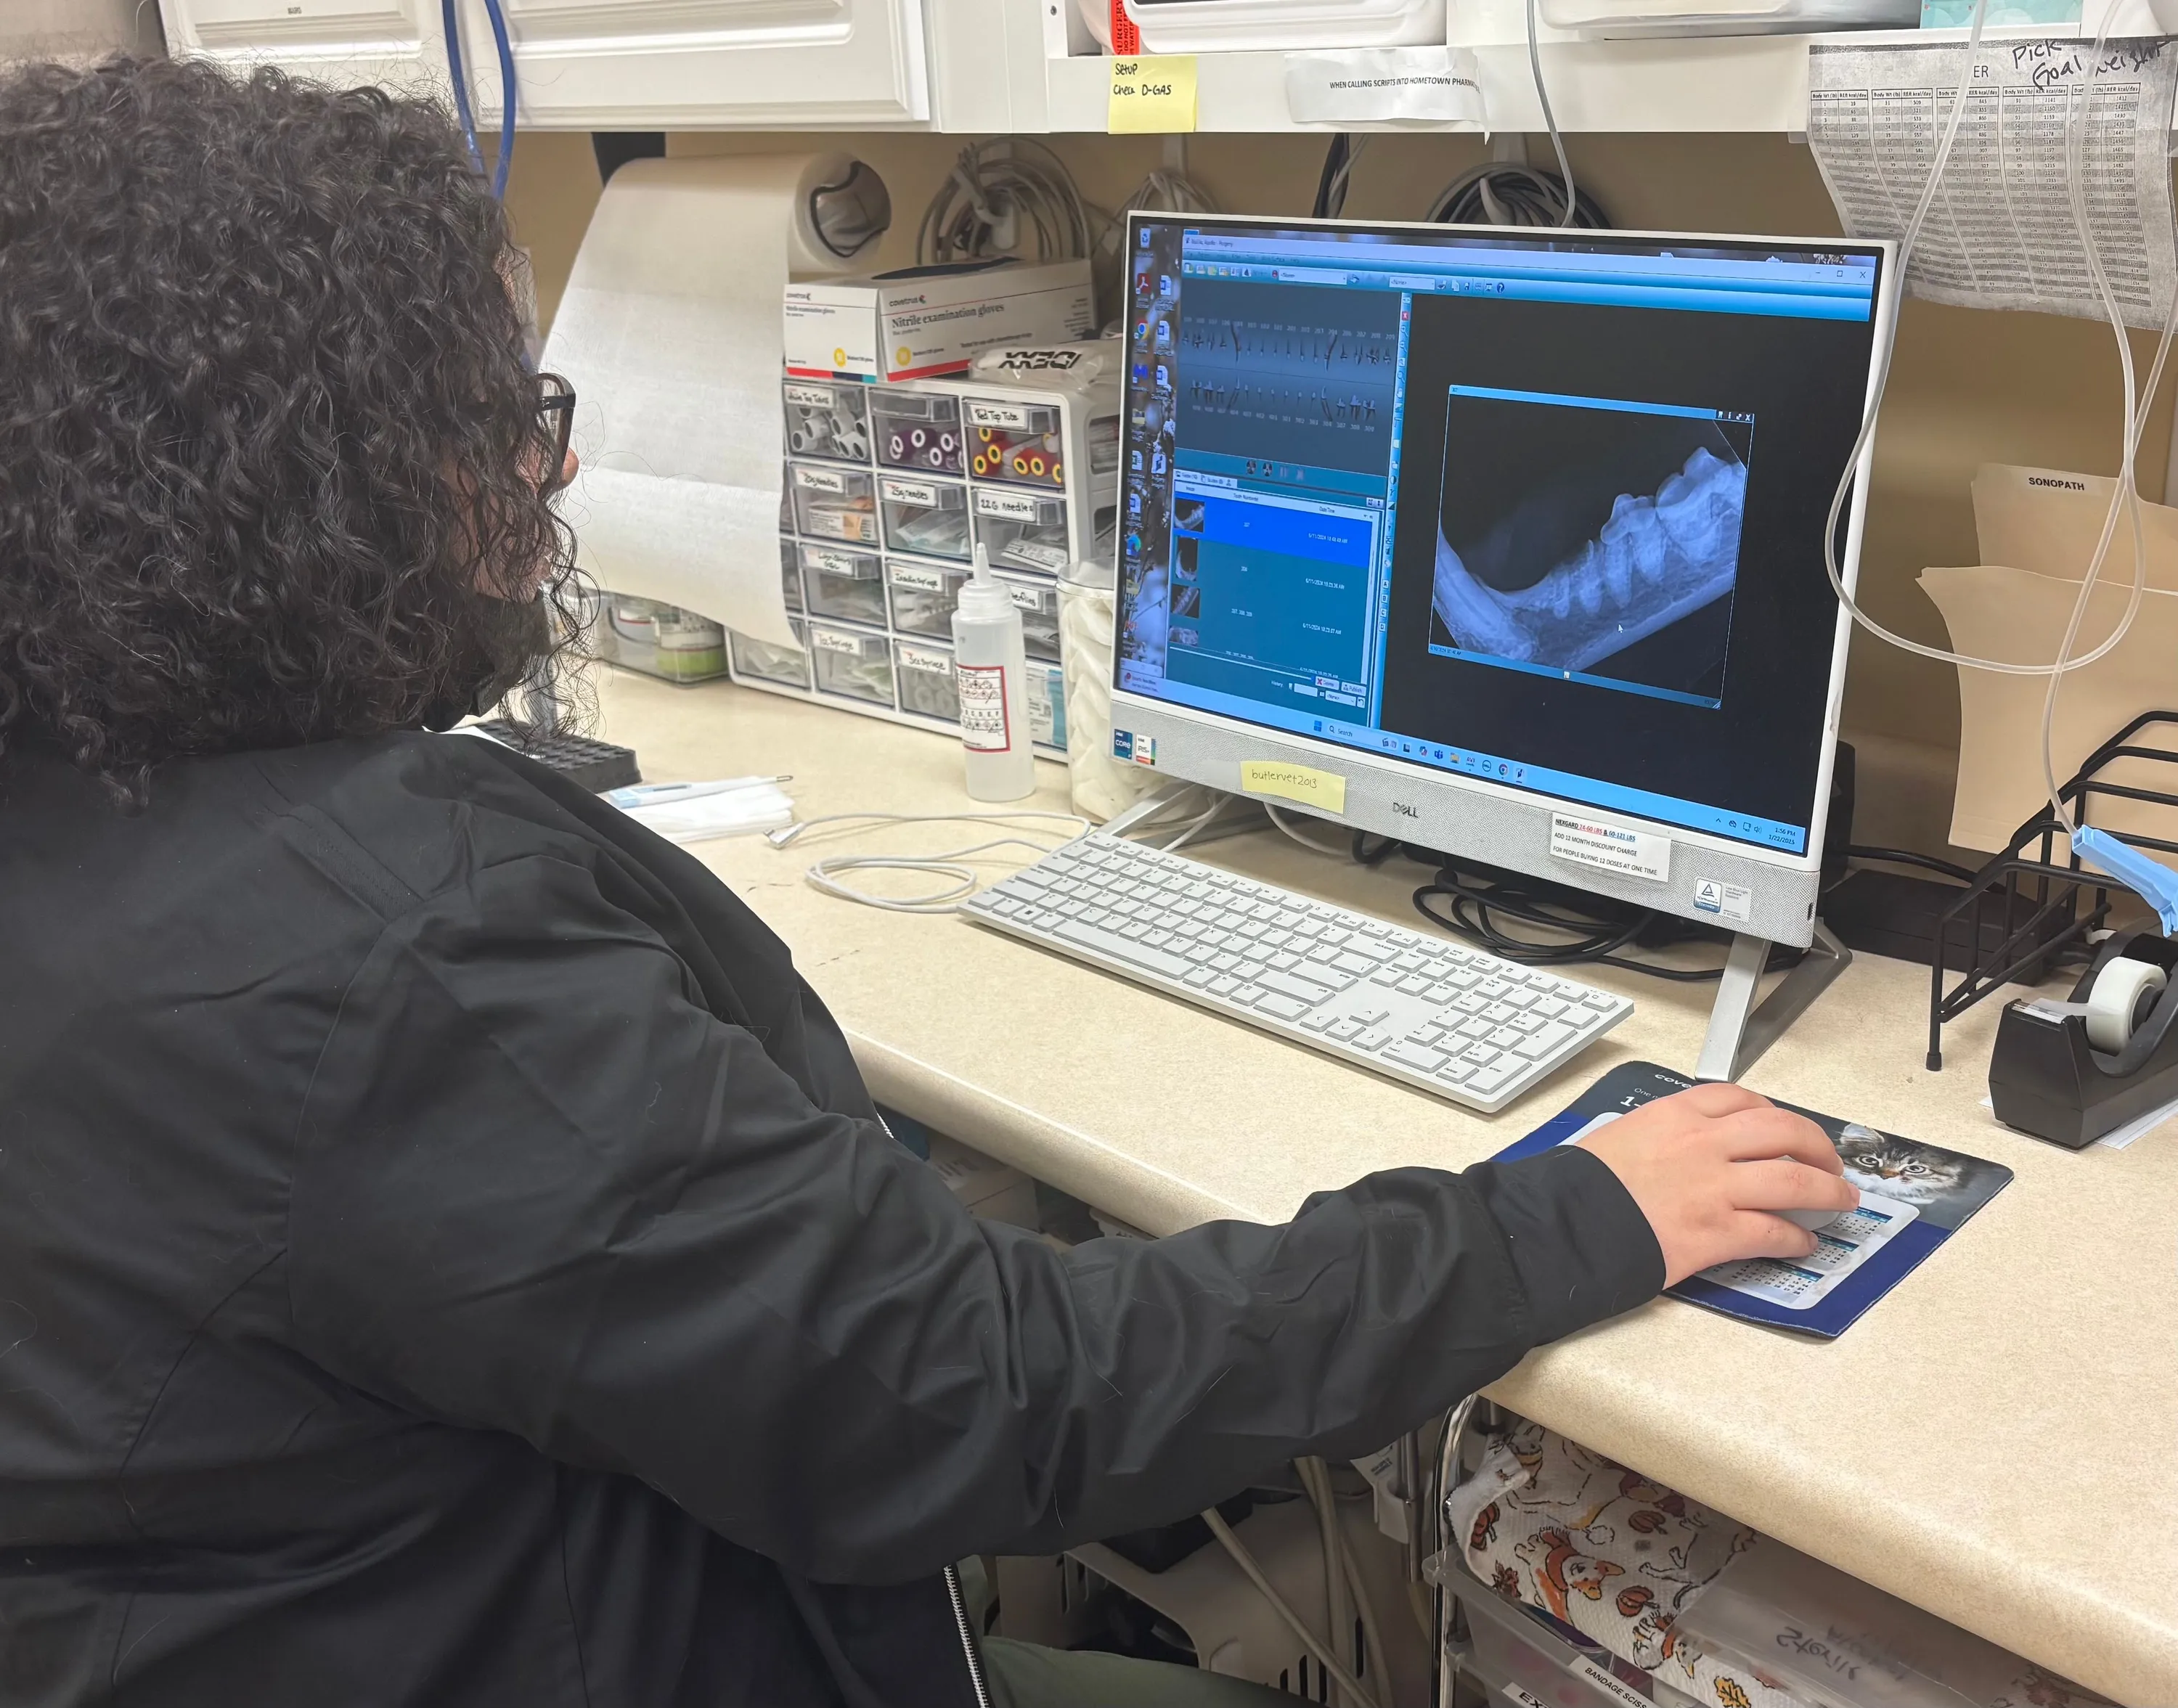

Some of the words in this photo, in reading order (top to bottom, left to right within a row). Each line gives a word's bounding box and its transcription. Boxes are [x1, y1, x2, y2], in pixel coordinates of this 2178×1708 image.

[1124, 42, 1129, 52] DO
[2012, 39, 2062, 69] Pick
[1142, 84, 1172, 96] D-GAS
[1347, 80, 1372, 89] CALLING
[892, 315, 921, 329] Nitrile
[923, 308, 976, 324] examination
[978, 303, 1005, 318] gloves
[2028, 476, 2085, 491] SONOPATH
[981, 499, 998, 510] 22G
[1337, 727, 1353, 737] Search
[1252, 769, 1318, 789] butlervet2013
[1392, 802, 1419, 819] DELL
[1555, 819, 1579, 830] NEXGARD
[1580, 823, 1594, 834] 24-60
[1609, 830, 1626, 840] 60-121
[1572, 836, 1591, 846] MONTH
[1591, 841, 1616, 851] DISCOUNT
[1617, 846, 1637, 857] CHARGE
[1769, 835, 1795, 845] 1/22/2025
[1562, 849, 1580, 858] PEOPLE
[1581, 852, 1599, 862] BUYING
[1606, 859, 1623, 868] DOSES
[1631, 864, 1643, 873] ONE
[1644, 867, 1657, 876] TIME
[1634, 1087, 1652, 1098] One
[1585, 1667, 1624, 1696] BANDAGE
